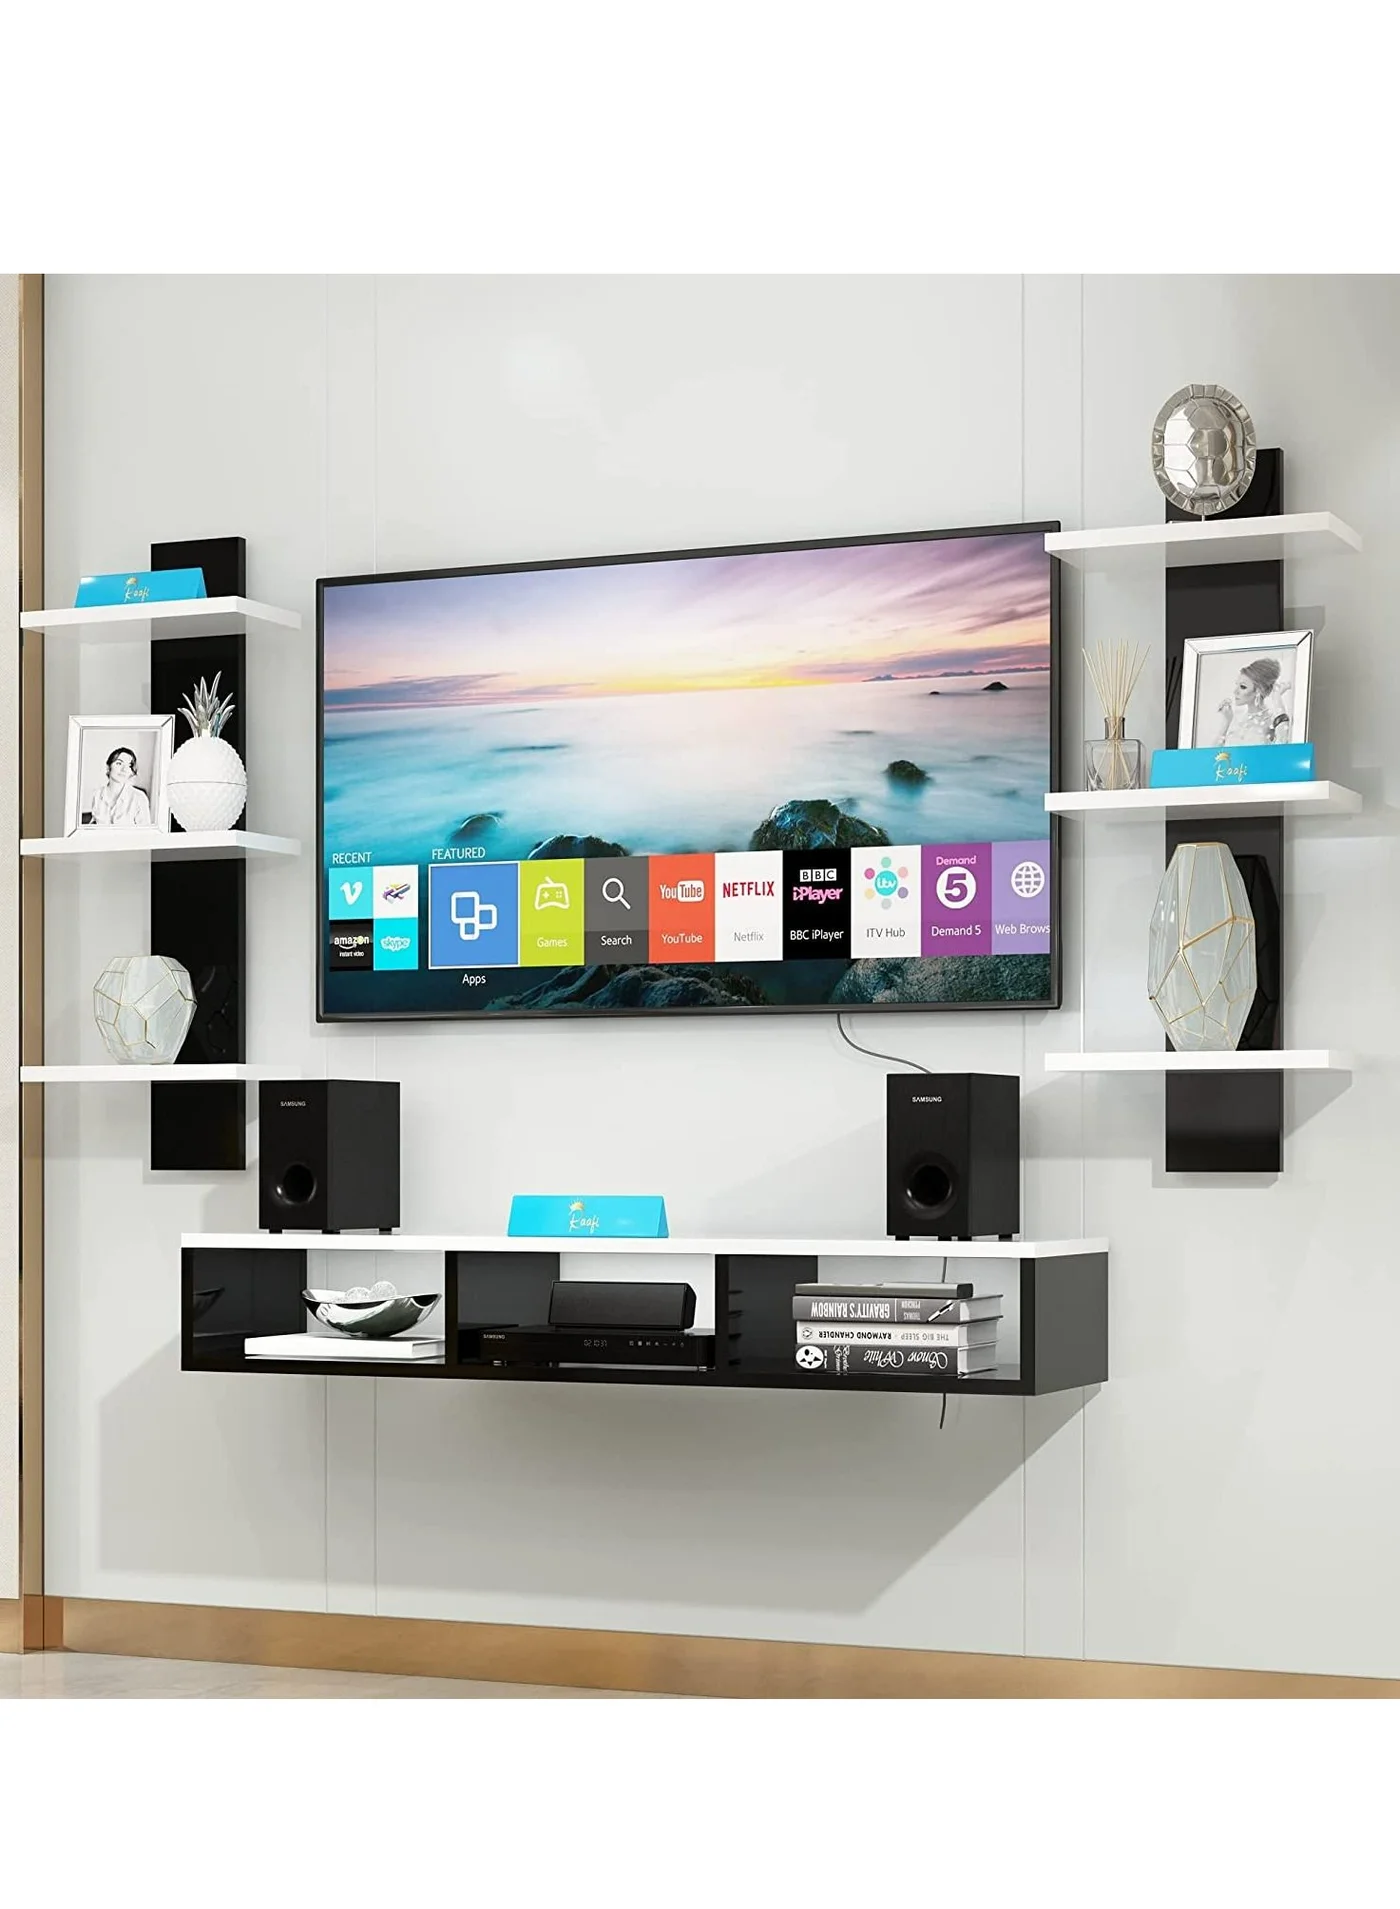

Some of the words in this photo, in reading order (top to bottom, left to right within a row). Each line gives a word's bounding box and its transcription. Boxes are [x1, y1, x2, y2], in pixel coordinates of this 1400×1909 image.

[332, 851, 373, 864] RECENT
[431, 847, 486, 860] FEATURED
[936, 855, 977, 866] Demand
[800, 868, 837, 882] BBC
[877, 877, 897, 889] itv
[943, 873, 968, 903] 5
[659, 880, 705, 903] YouTube
[722, 881, 775, 899] NETFLIX
[792, 886, 844, 905] iPlayer
[866, 928, 883, 938] ITV
[886, 928, 906, 938] Hub
[931, 926, 972, 937] Demand
[975, 925, 982, 935] 5
[995, 924, 1017, 934] Web
[1019, 923, 1050, 934] Brows
[334, 934, 370, 946] amazon
[536, 936, 568, 948] Games
[600, 935, 633, 946] Search
[661, 933, 703, 944] YouTube
[733, 931, 764, 942] Netflix
[790, 929, 809, 941] BBC
[811, 929, 844, 944] iPlayer
[382, 938, 409, 950] skype
[462, 973, 487, 986] Apps
[811, 1302, 849, 1317] RAINBOW
[849, 1302, 890, 1318] GRAVITY'S
[818, 1331, 854, 1339] CHANDLER
[856, 1331, 892, 1340] RAYMOND
[900, 1333, 921, 1341] SLEEP
[864, 1350, 904, 1368] White
[907, 1352, 948, 1369] Snow
